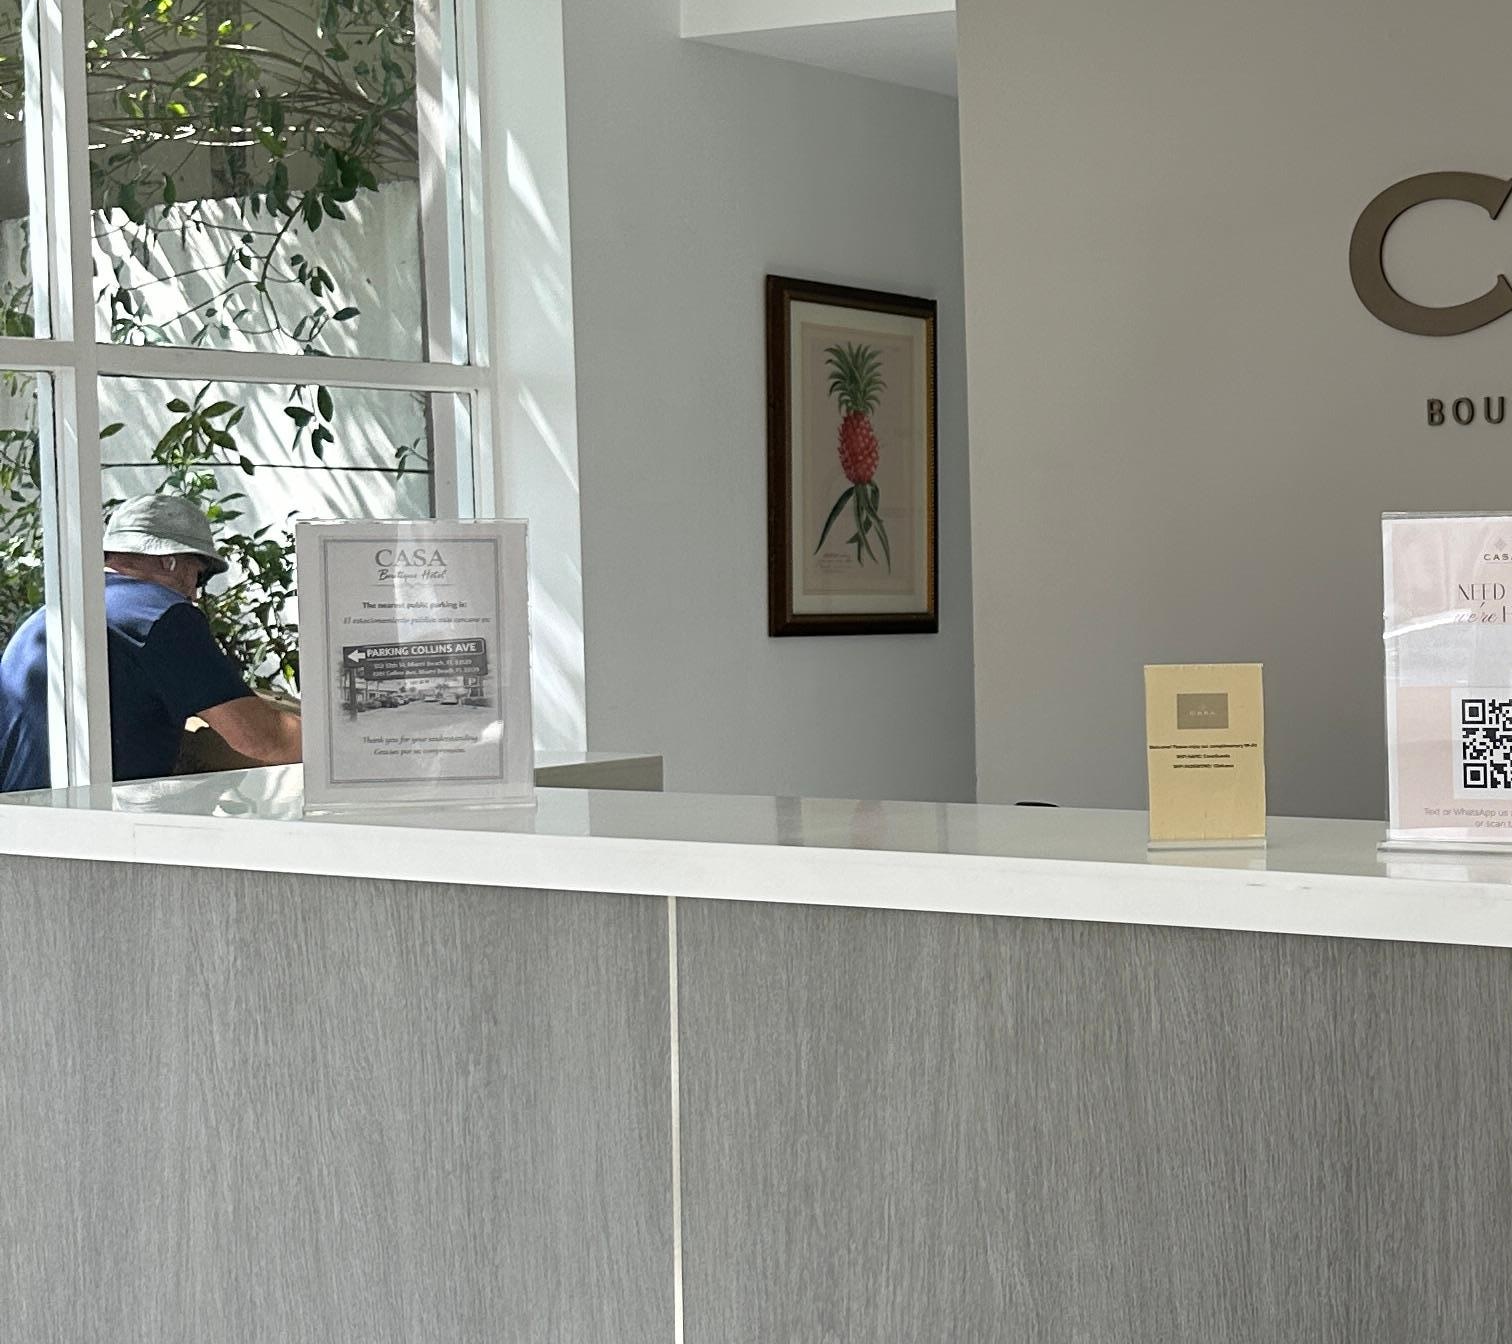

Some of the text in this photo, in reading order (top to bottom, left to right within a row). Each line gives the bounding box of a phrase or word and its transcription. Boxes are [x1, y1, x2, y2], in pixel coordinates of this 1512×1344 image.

[375, 548, 447, 567] CASA
[422, 570, 448, 579] Hotel
[1459, 583, 1505, 600] NEED
[367, 643, 476, 657] PARKING COLLINS AVE
[1424, 808, 1439, 816] Text
[1453, 808, 1495, 817] WhatsApp
